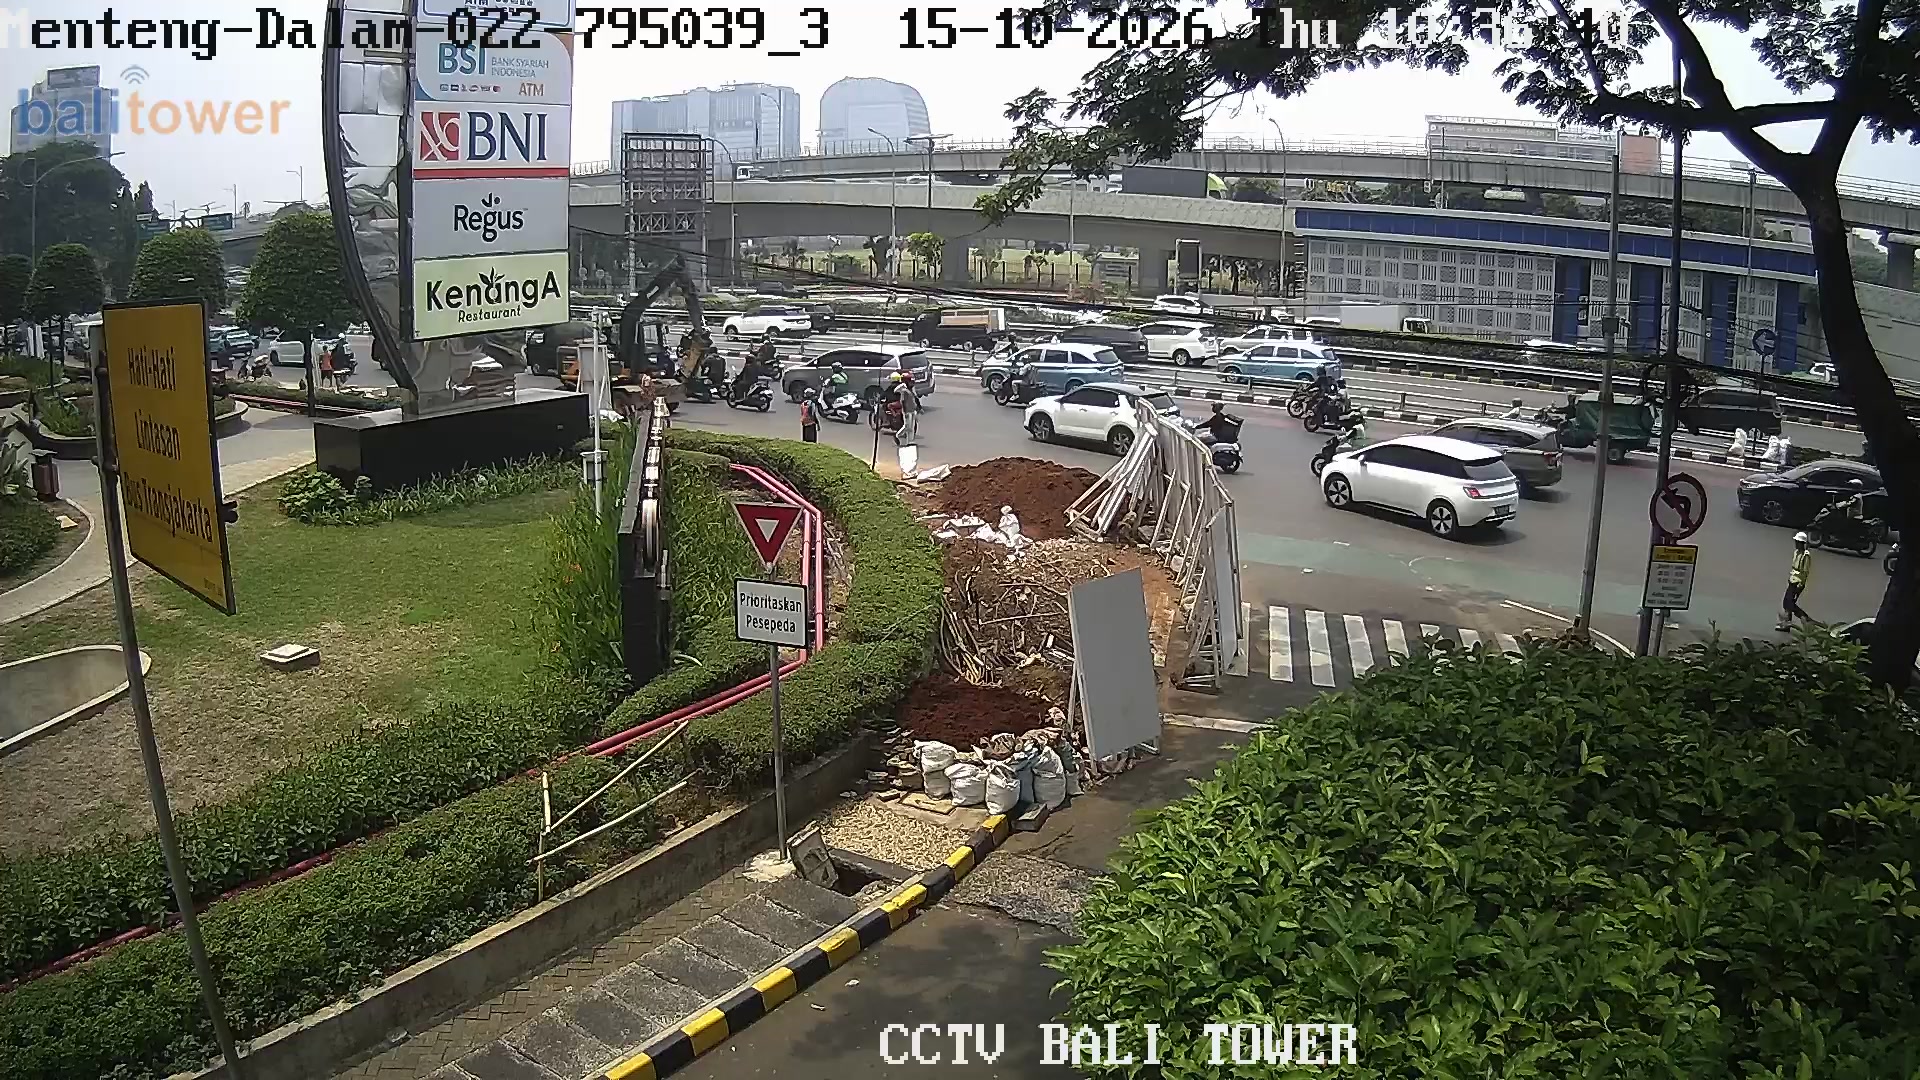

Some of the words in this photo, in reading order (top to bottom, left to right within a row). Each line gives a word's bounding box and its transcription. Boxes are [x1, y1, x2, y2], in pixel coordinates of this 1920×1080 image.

[438, 43, 486, 75] BSI
[491, 57, 515, 67] BANK
[516, 58, 549, 69] SYARIAH
[491, 67, 536, 78] INDONESIA
[518, 82, 544, 97] ATM
[466, 111, 548, 163] BNI
[453, 204, 524, 243] Regus
[457, 305, 522, 323] Restaurant
[127, 345, 176, 392] Hati-Hati
[134, 409, 181, 461] Lintasan
[740, 592, 802, 613] Prioritaskan
[746, 614, 796, 634] Pesepeda
